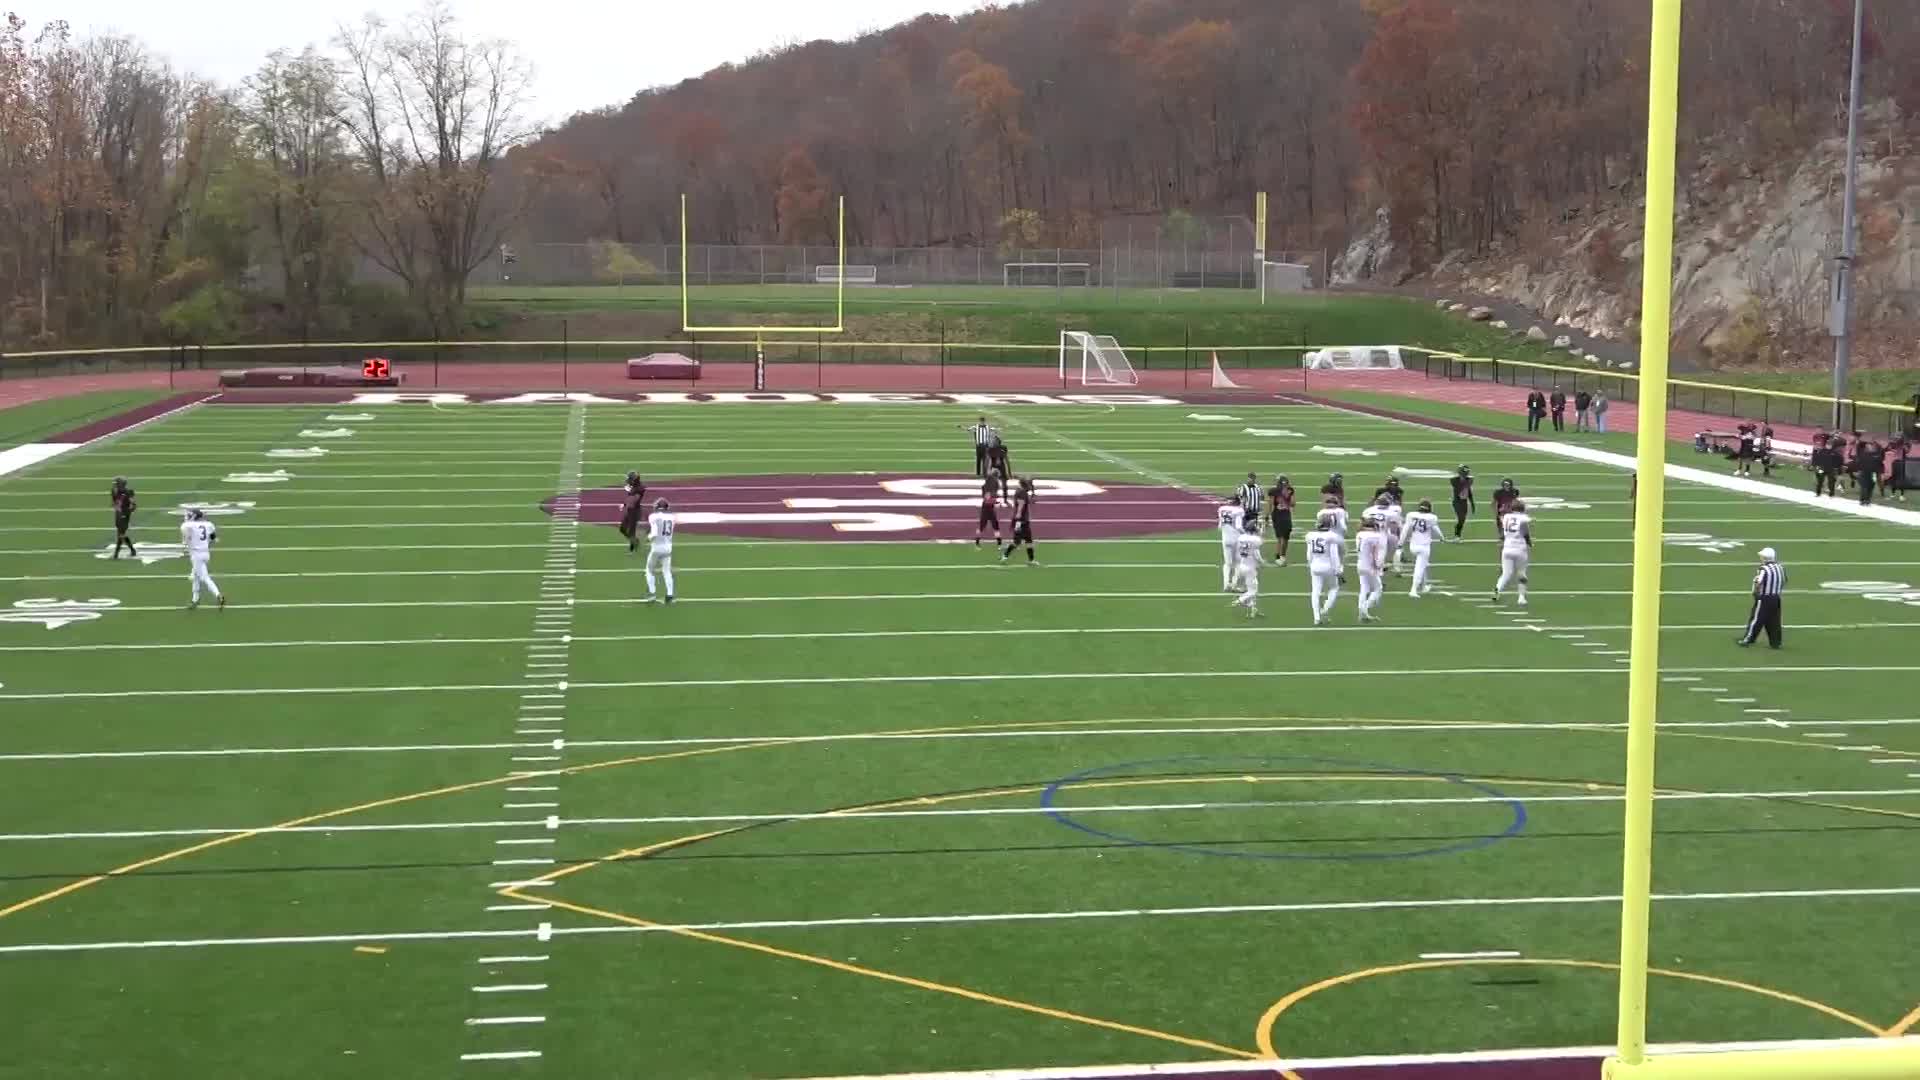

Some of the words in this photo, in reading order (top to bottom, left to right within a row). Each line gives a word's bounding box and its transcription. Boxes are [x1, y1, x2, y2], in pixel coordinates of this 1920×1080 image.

[363, 359, 388, 378] 22
[339, 392, 1184, 404] RAIDERS
[199, 525, 207, 541] 3
[661, 519, 673, 536] 13
[1412, 518, 1427, 533] 79
[1505, 517, 1518, 533] 12
[1311, 537, 1325, 554] 15
